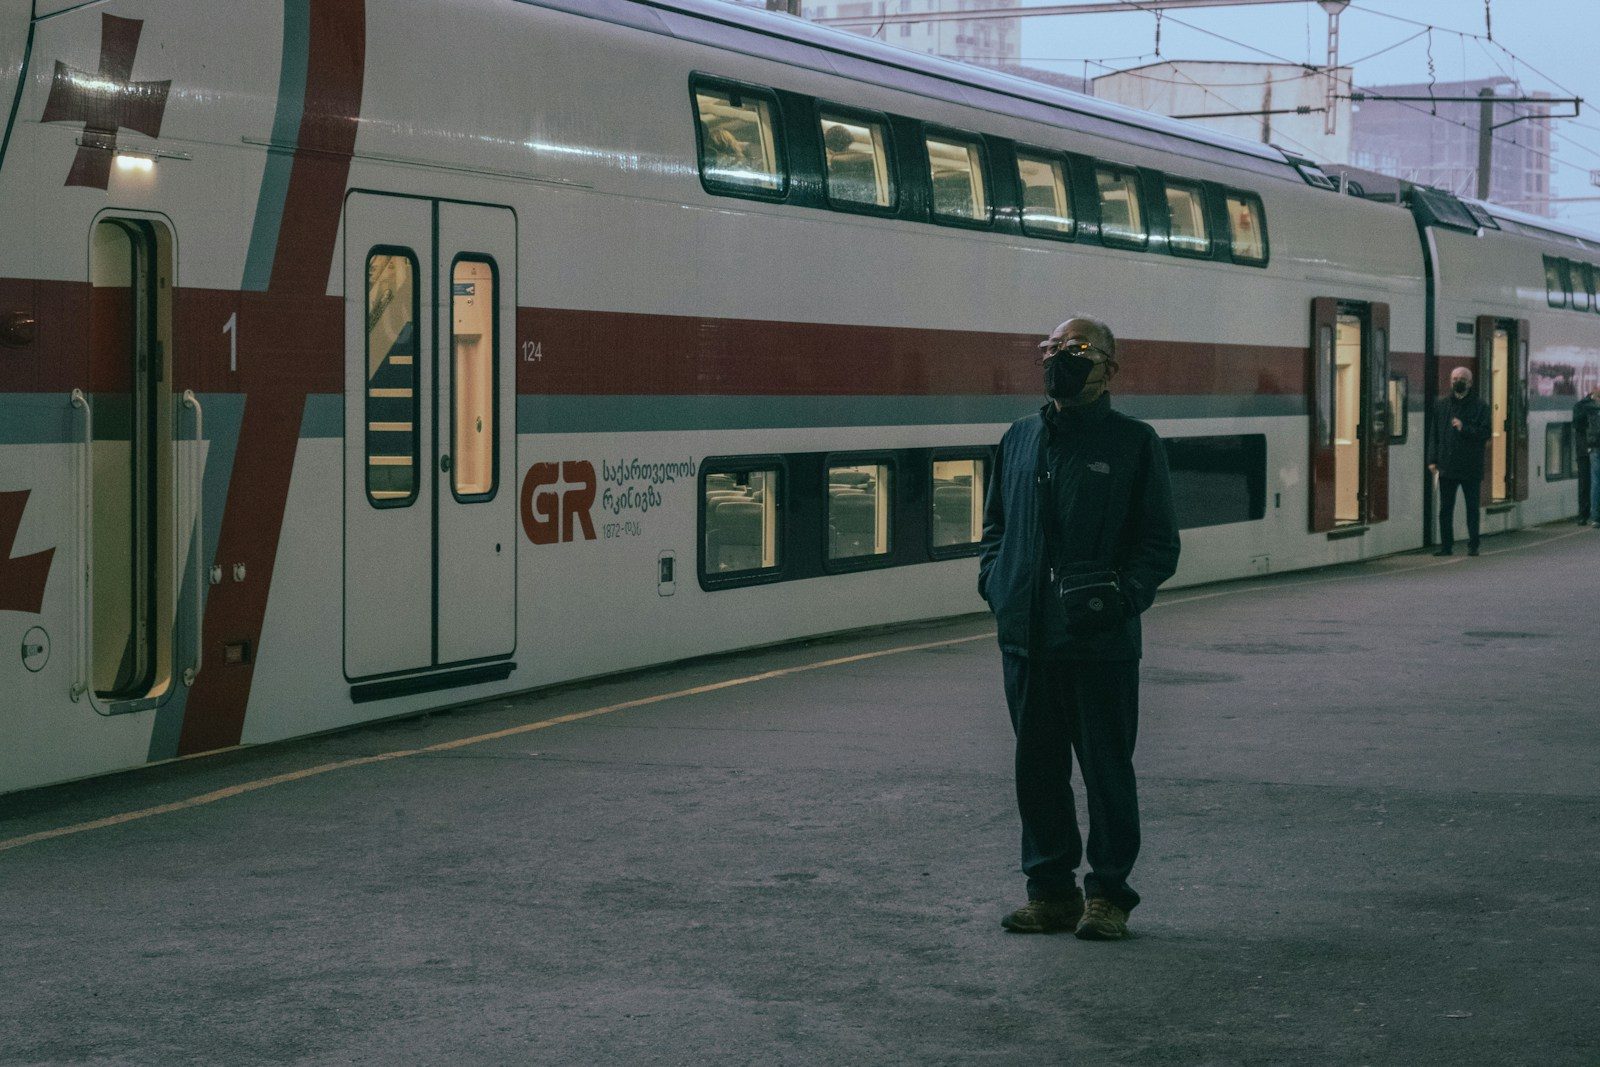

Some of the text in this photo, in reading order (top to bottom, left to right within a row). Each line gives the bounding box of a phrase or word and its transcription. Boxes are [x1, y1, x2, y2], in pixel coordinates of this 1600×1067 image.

[223, 312, 237, 372] 1
[521, 341, 543, 362] 124
[602, 456, 696, 486] საქართველოს
[520, 460, 597, 545] GR
[602, 485, 662, 515] რკინიგზა
